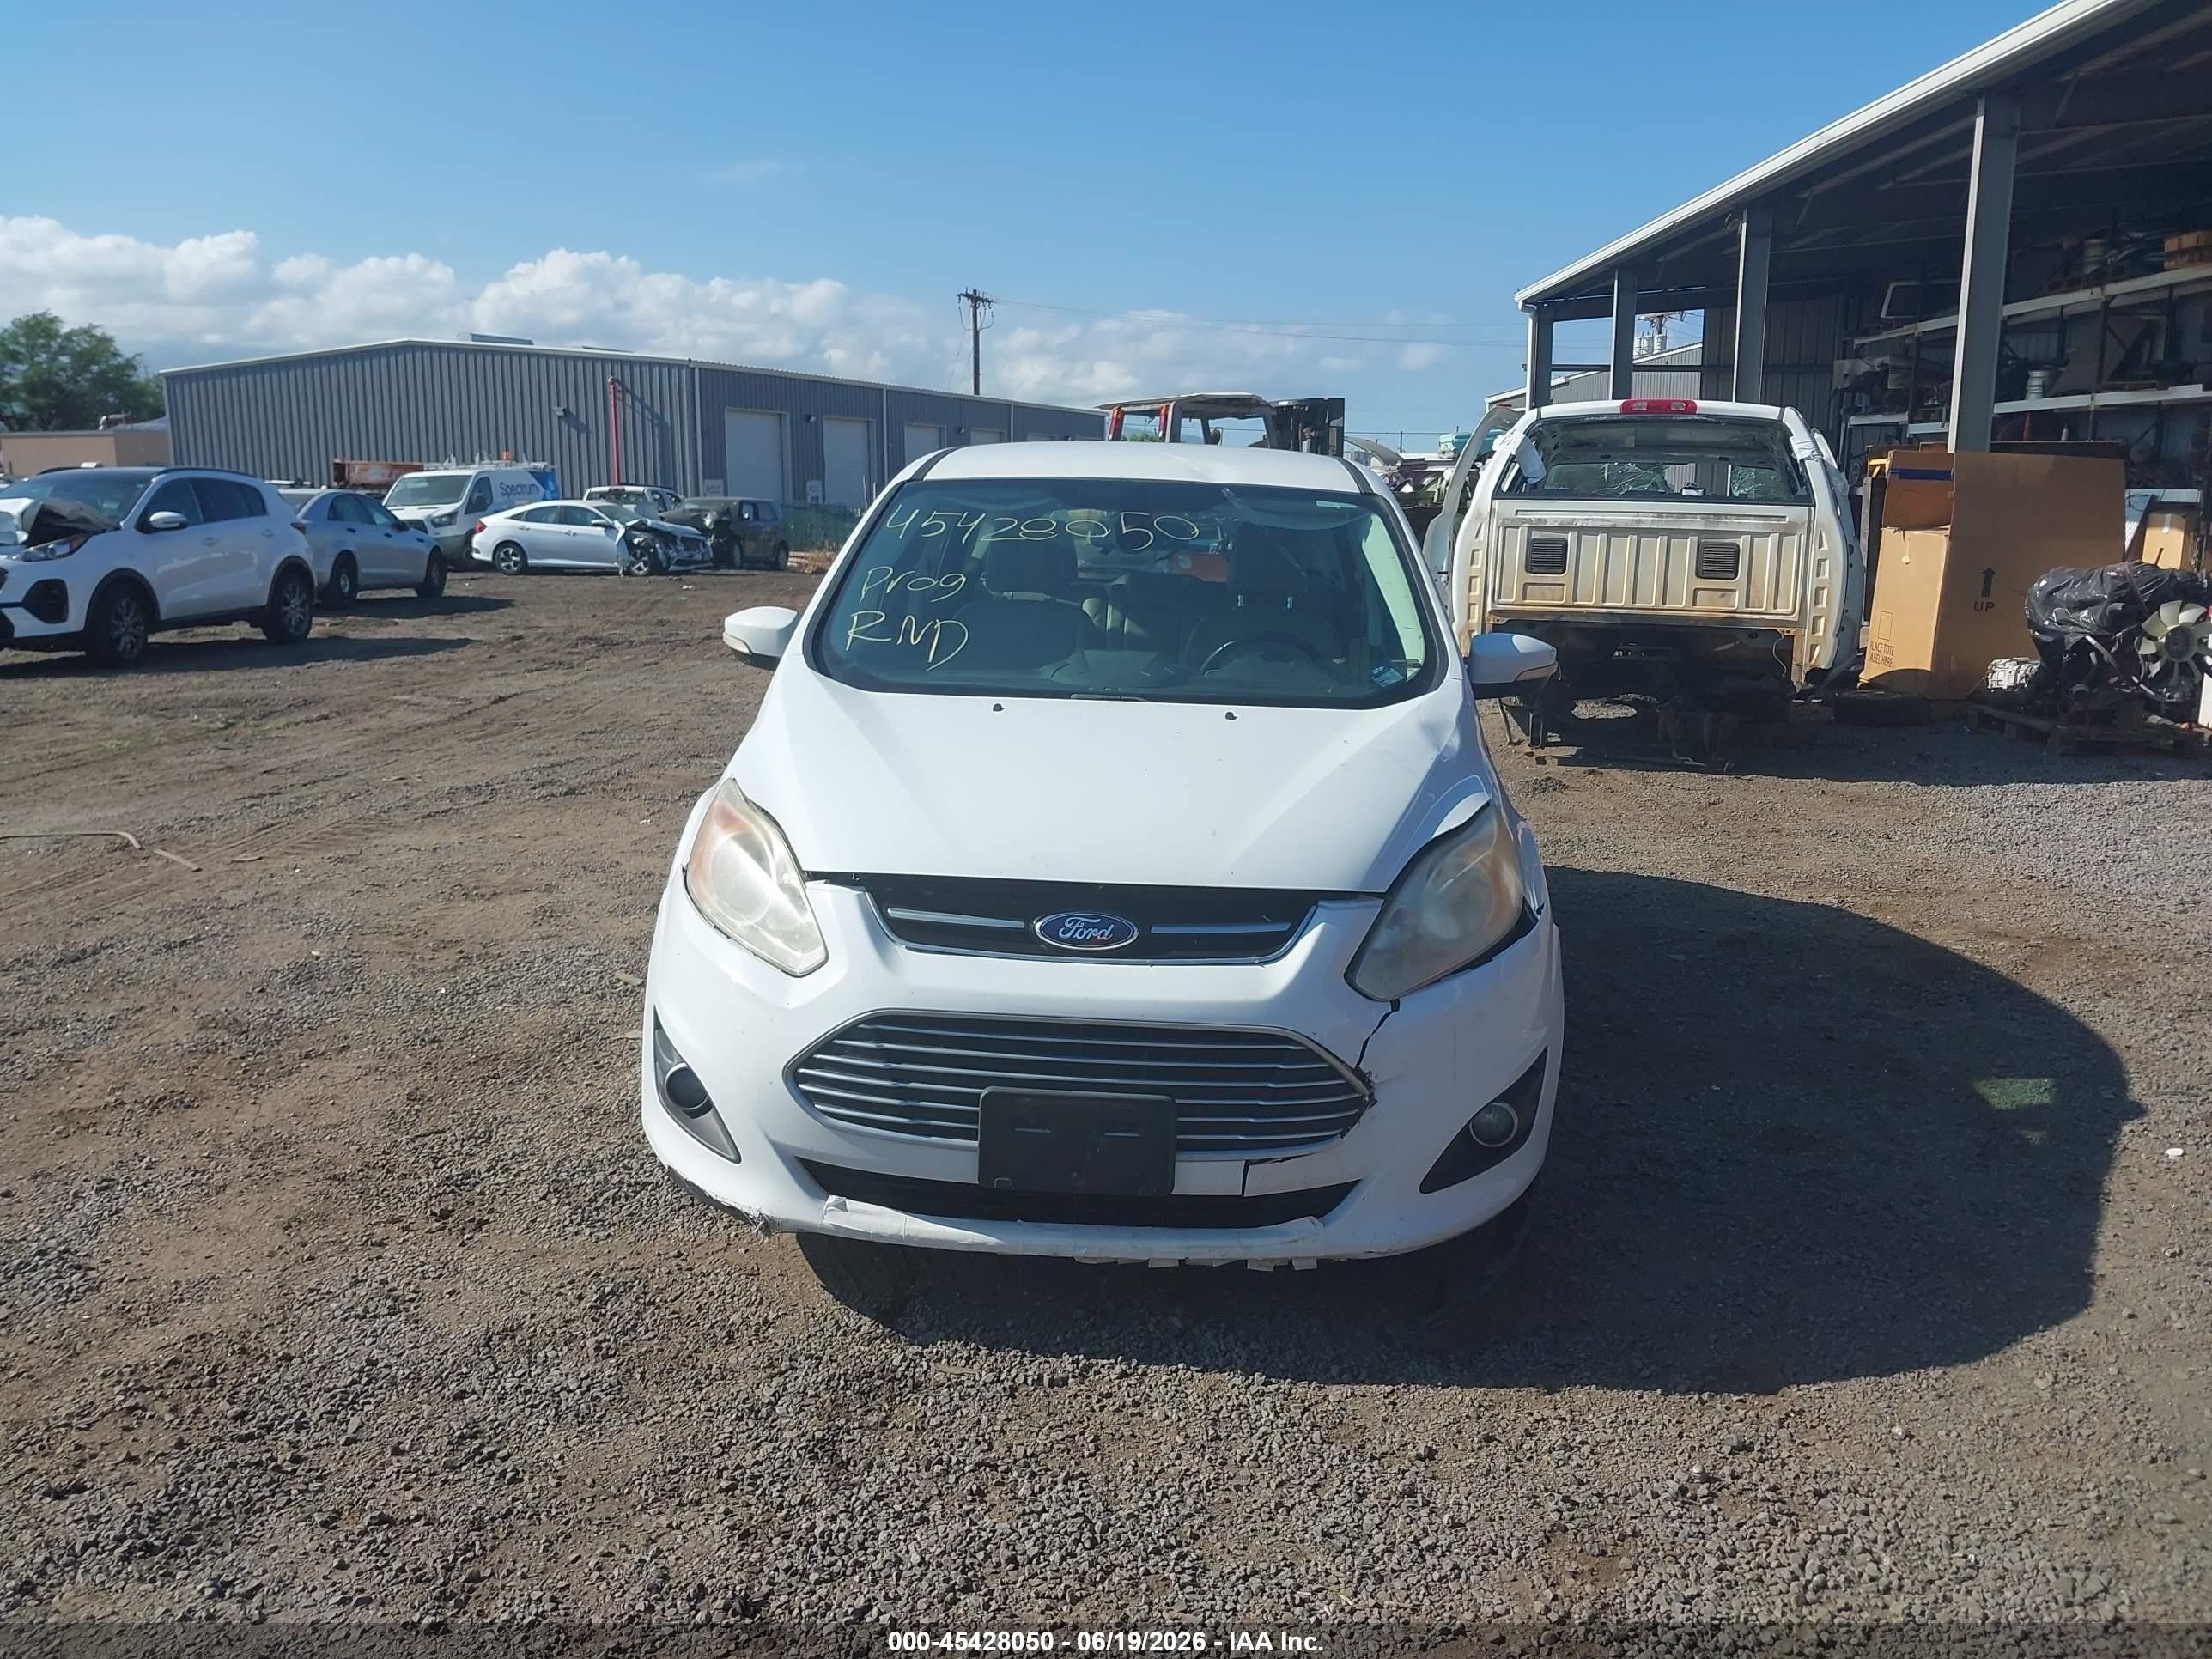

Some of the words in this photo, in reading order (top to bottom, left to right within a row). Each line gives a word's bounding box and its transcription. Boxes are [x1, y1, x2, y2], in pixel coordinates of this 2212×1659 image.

[500, 481, 538, 497] Spectrum
[886, 504, 1200, 550] 45428050
[1974, 600, 1996, 612] UP
[845, 610, 969, 672] RND
[1058, 916, 1115, 941] Ford
